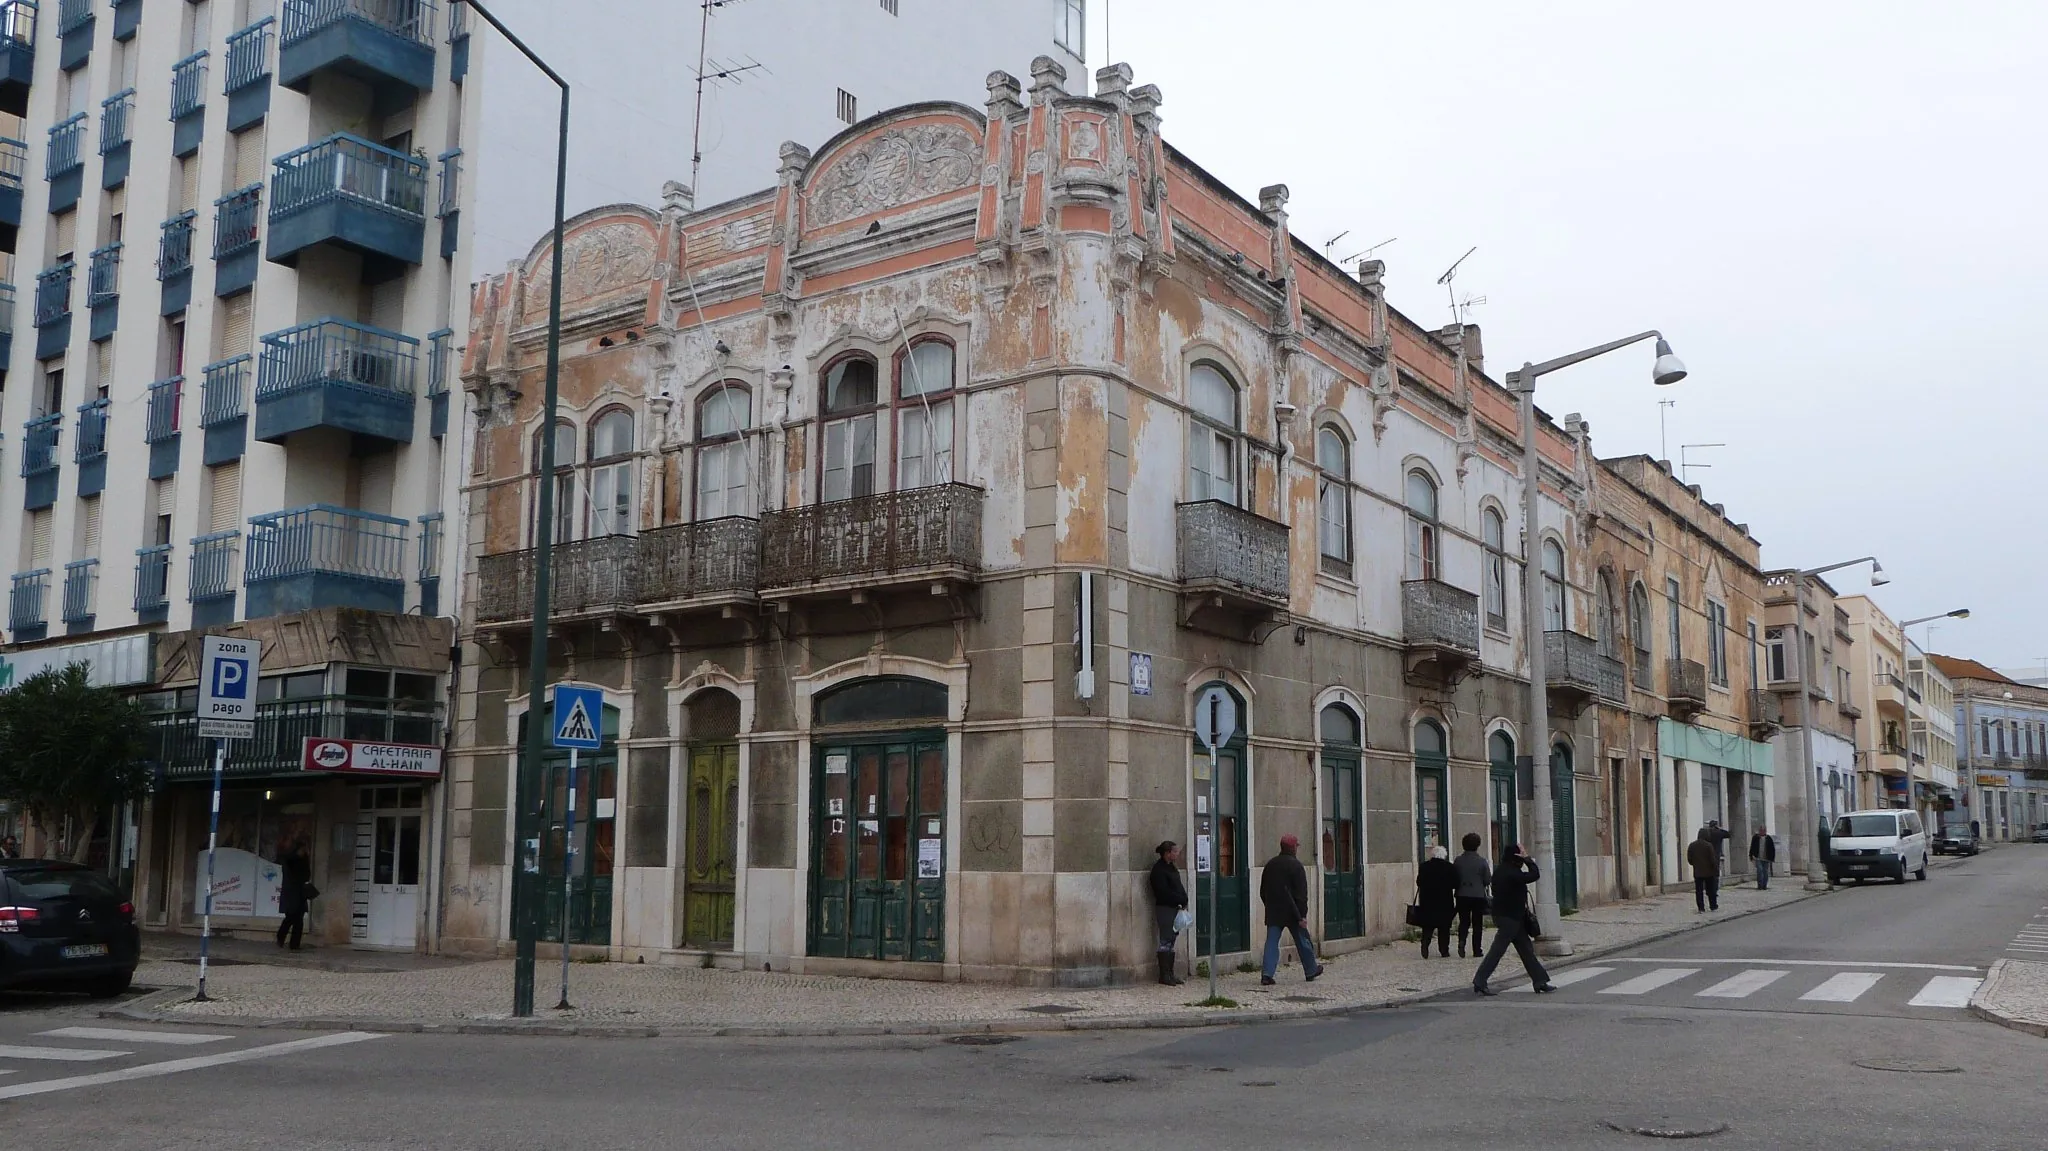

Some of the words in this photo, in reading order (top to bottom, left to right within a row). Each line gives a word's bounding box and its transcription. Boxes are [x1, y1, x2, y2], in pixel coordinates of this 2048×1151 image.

[219, 643, 247, 654] zona
[218, 660, 242, 696] P
[212, 703, 242, 715] pago
[362, 745, 432, 759] CAFETARIA
[371, 758, 423, 770] AL-HAIN
